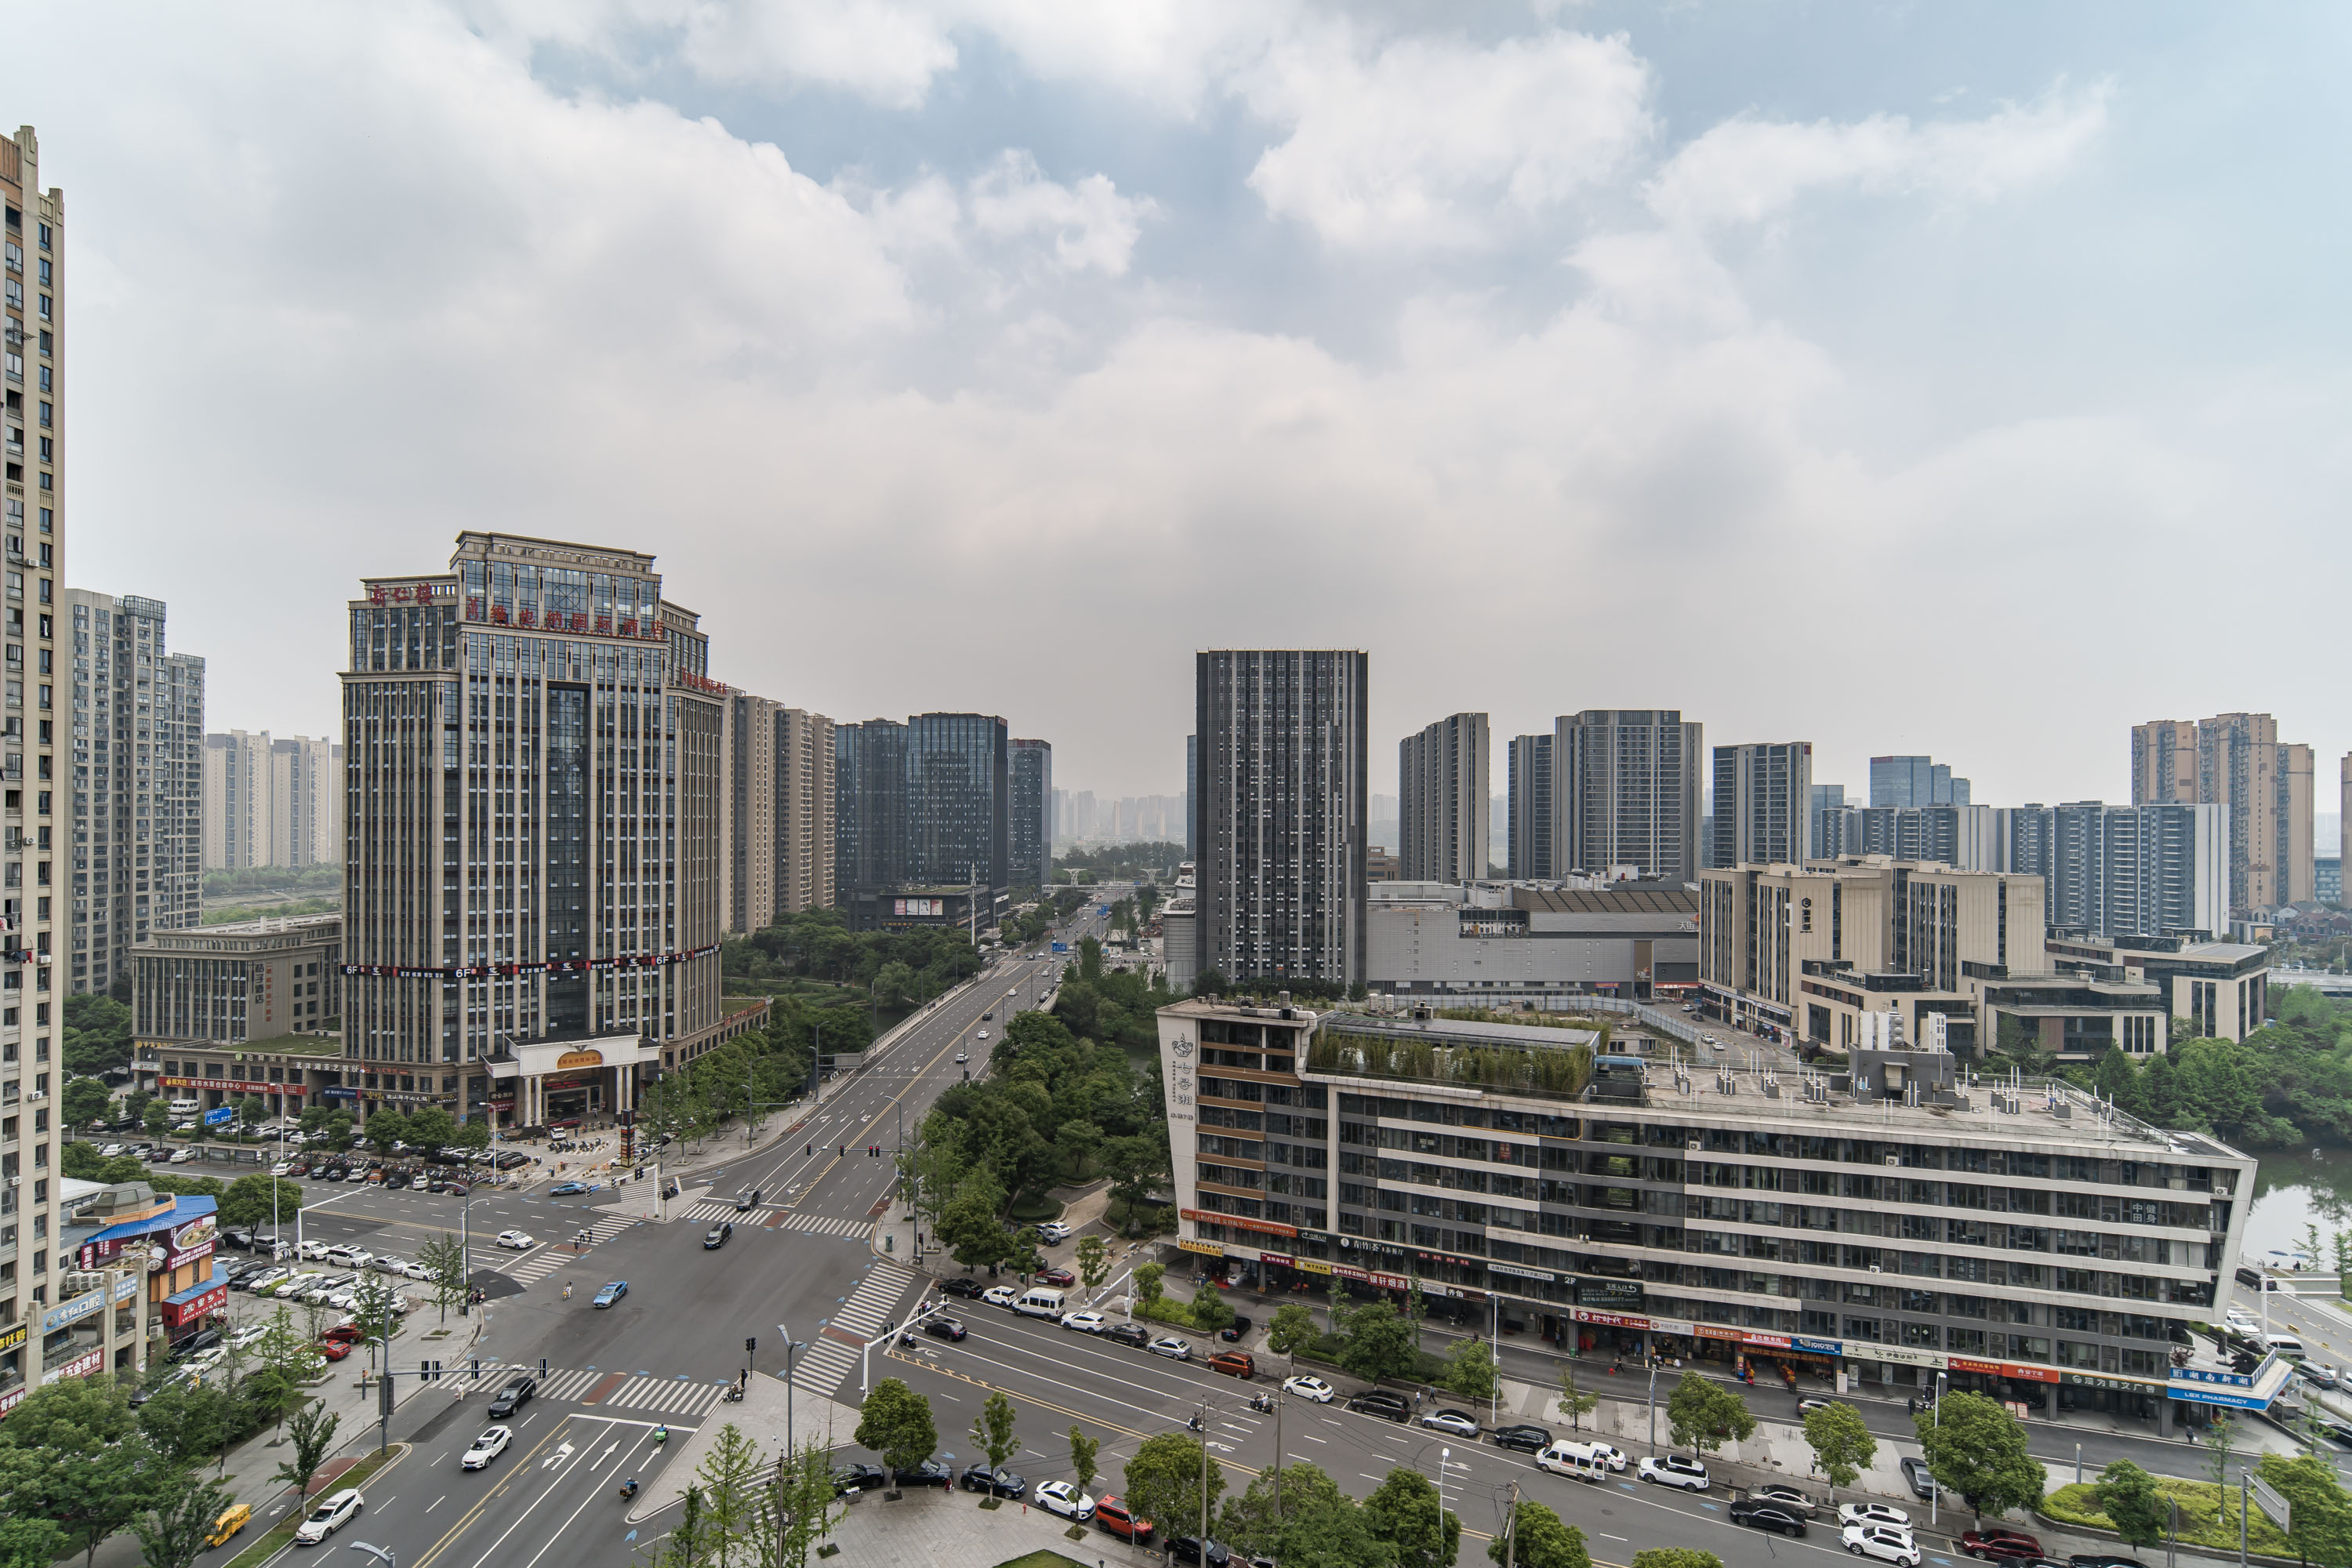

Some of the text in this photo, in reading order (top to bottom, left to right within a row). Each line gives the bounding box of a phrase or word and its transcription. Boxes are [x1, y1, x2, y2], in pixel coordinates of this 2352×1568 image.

[490, 604, 665, 636] 维也纳国际酒店
[1678, 921, 1695, 930] 天街
[656, 956, 670, 965] 6F
[347, 965, 358, 975] 6F
[456, 968, 470, 978] 6F
[1176, 1062, 1192, 1105] 七号湘
[1385, 1247, 1404, 1256] 茶餐厅
[1370, 1274, 1406, 1290] 银轩烟酒
[1564, 1276, 1576, 1285] 2F
[1448, 1289, 1464, 1298] 乔伯
[66, 1351, 101, 1377] 五金建材
[2189, 1370, 2249, 1385] 湖南新湖
[2202, 1394, 2248, 1405] PHARMACY
